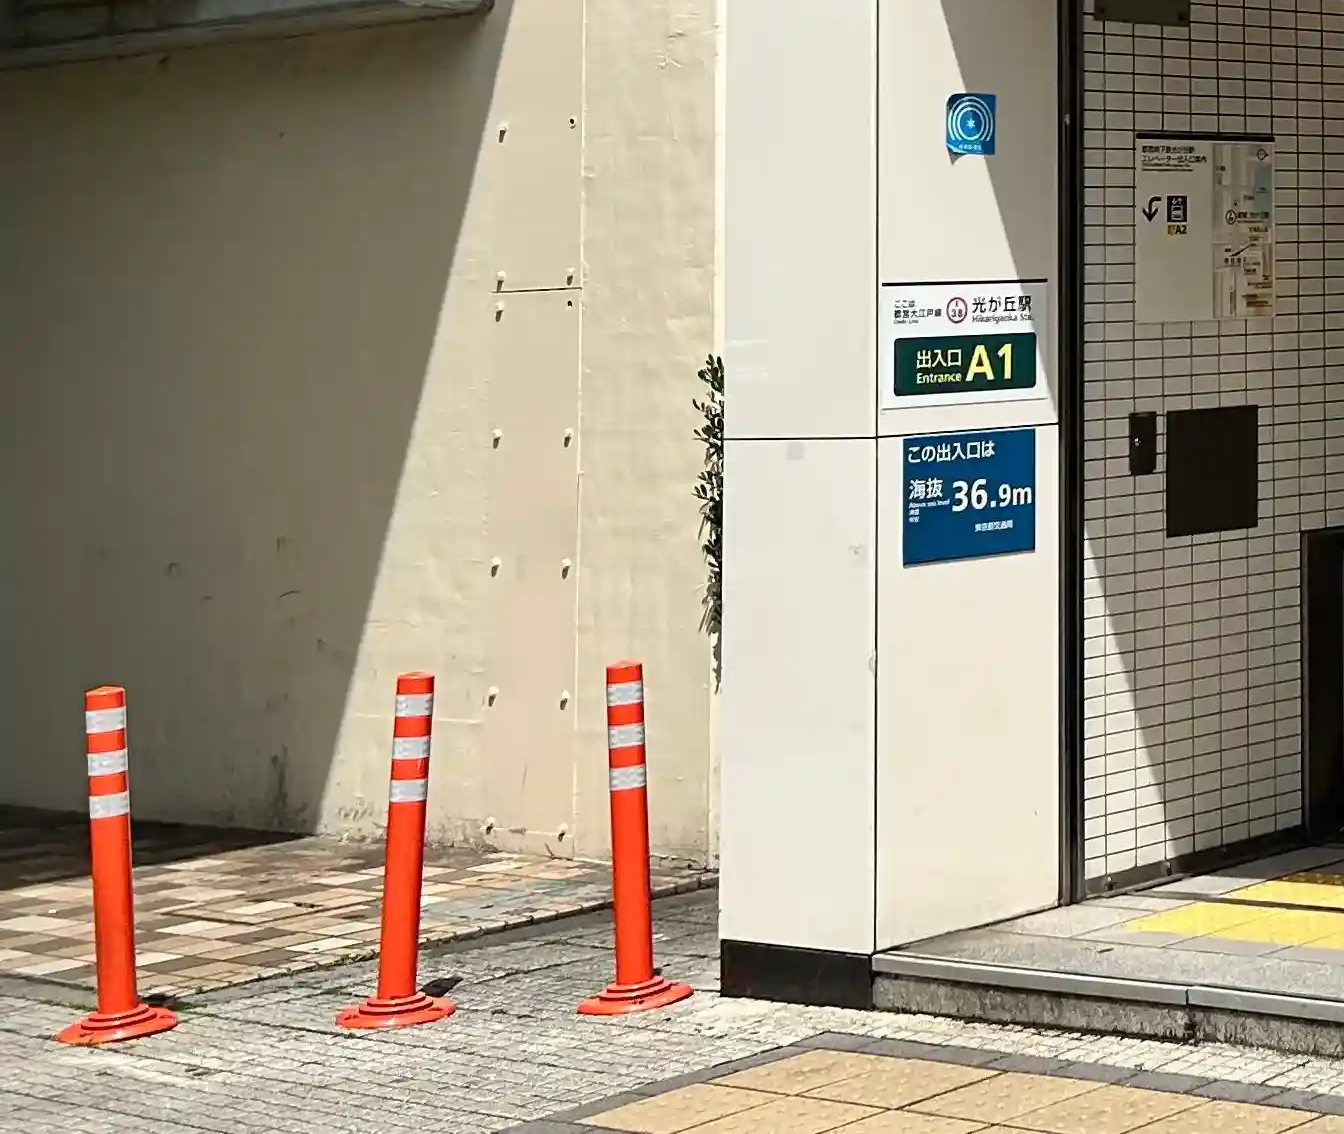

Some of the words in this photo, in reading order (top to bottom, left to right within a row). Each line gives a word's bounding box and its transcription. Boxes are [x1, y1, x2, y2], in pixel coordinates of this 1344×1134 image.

[1175, 225, 1188, 235] A2
[971, 295, 1032, 314] 光が丘駅
[916, 349, 962, 369] 出入口
[965, 343, 1013, 382] A1
[916, 372, 962, 384] Entrance
[907, 439, 995, 463] この出入口は
[908, 477, 944, 500] 海抜
[951, 478, 1033, 512] 36.9m
